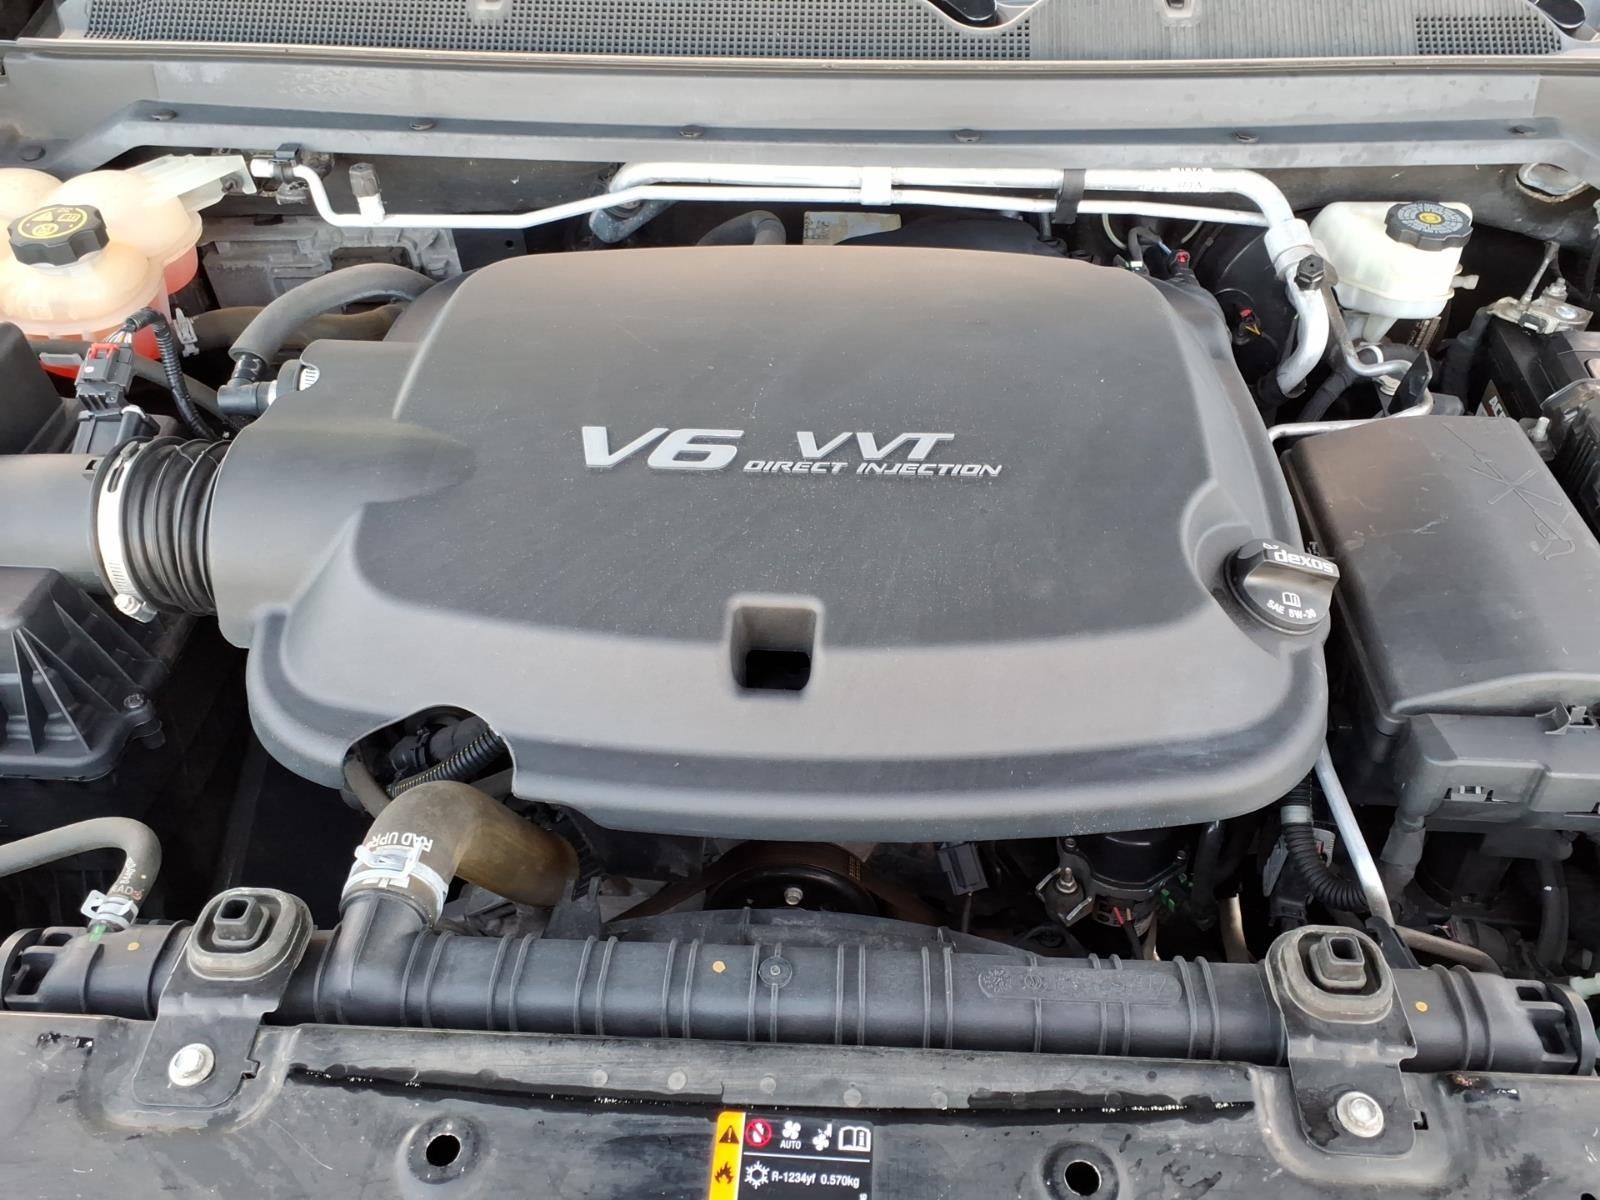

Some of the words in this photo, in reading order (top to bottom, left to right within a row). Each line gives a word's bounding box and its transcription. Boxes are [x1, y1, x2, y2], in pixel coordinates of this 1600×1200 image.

[581, 425, 744, 471] V6
[796, 430, 955, 461] VVT
[743, 460, 848, 475] DIRECT
[856, 462, 1002, 478] INJECTION
[1274, 549, 1334, 573] dexos
[1266, 599, 1285, 615] SAE
[401, 832, 433, 852] RAD
[780, 1139, 802, 1150] AUTO
[771, 1170, 816, 1185] R-1234yf
[820, 1173, 860, 1189] 0.570kg
